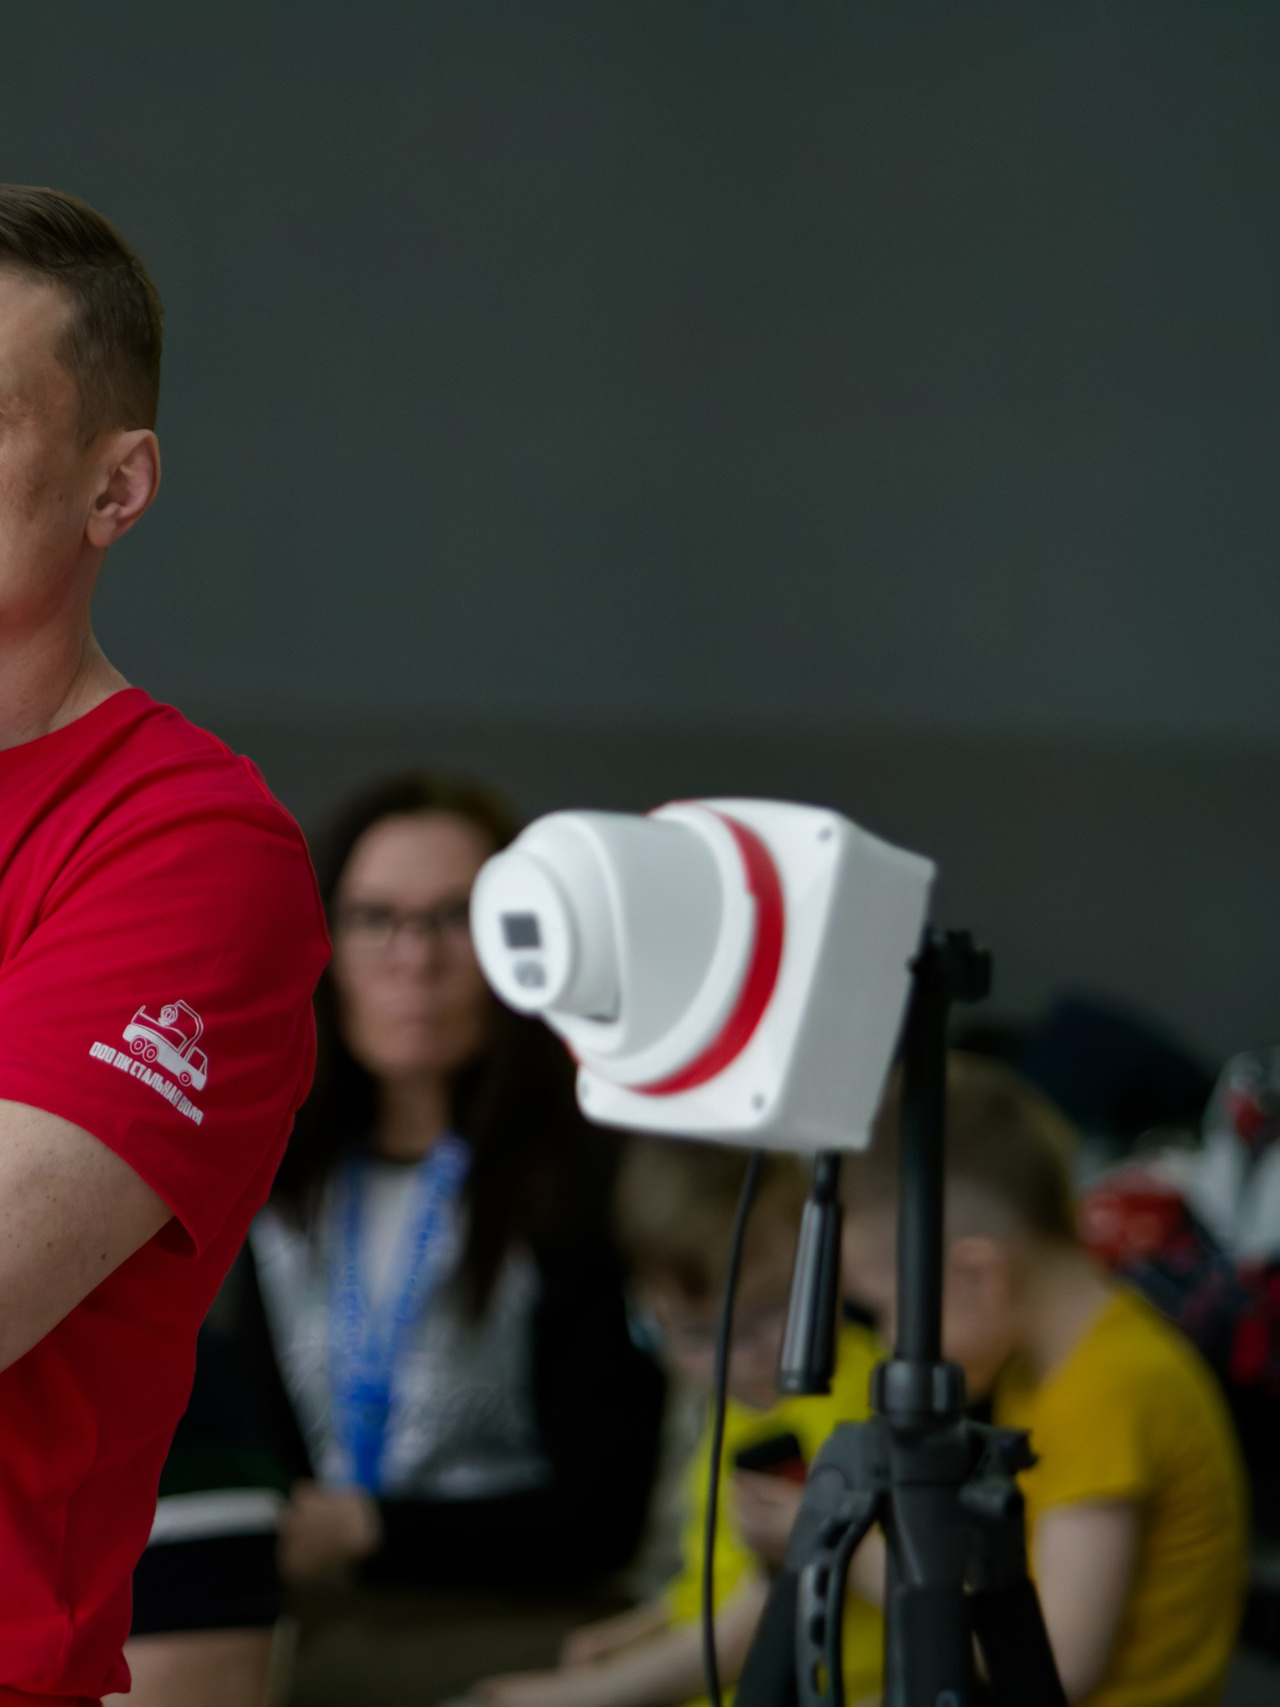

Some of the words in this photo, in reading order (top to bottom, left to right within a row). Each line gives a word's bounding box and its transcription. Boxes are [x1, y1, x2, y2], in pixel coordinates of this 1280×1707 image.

[89, 1041, 117, 1064] ООО
[113, 1052, 133, 1072] ПК
[129, 1061, 183, 1107] СТАЛЬНАЯ
[176, 1095, 204, 1126] ВОЛЯ
